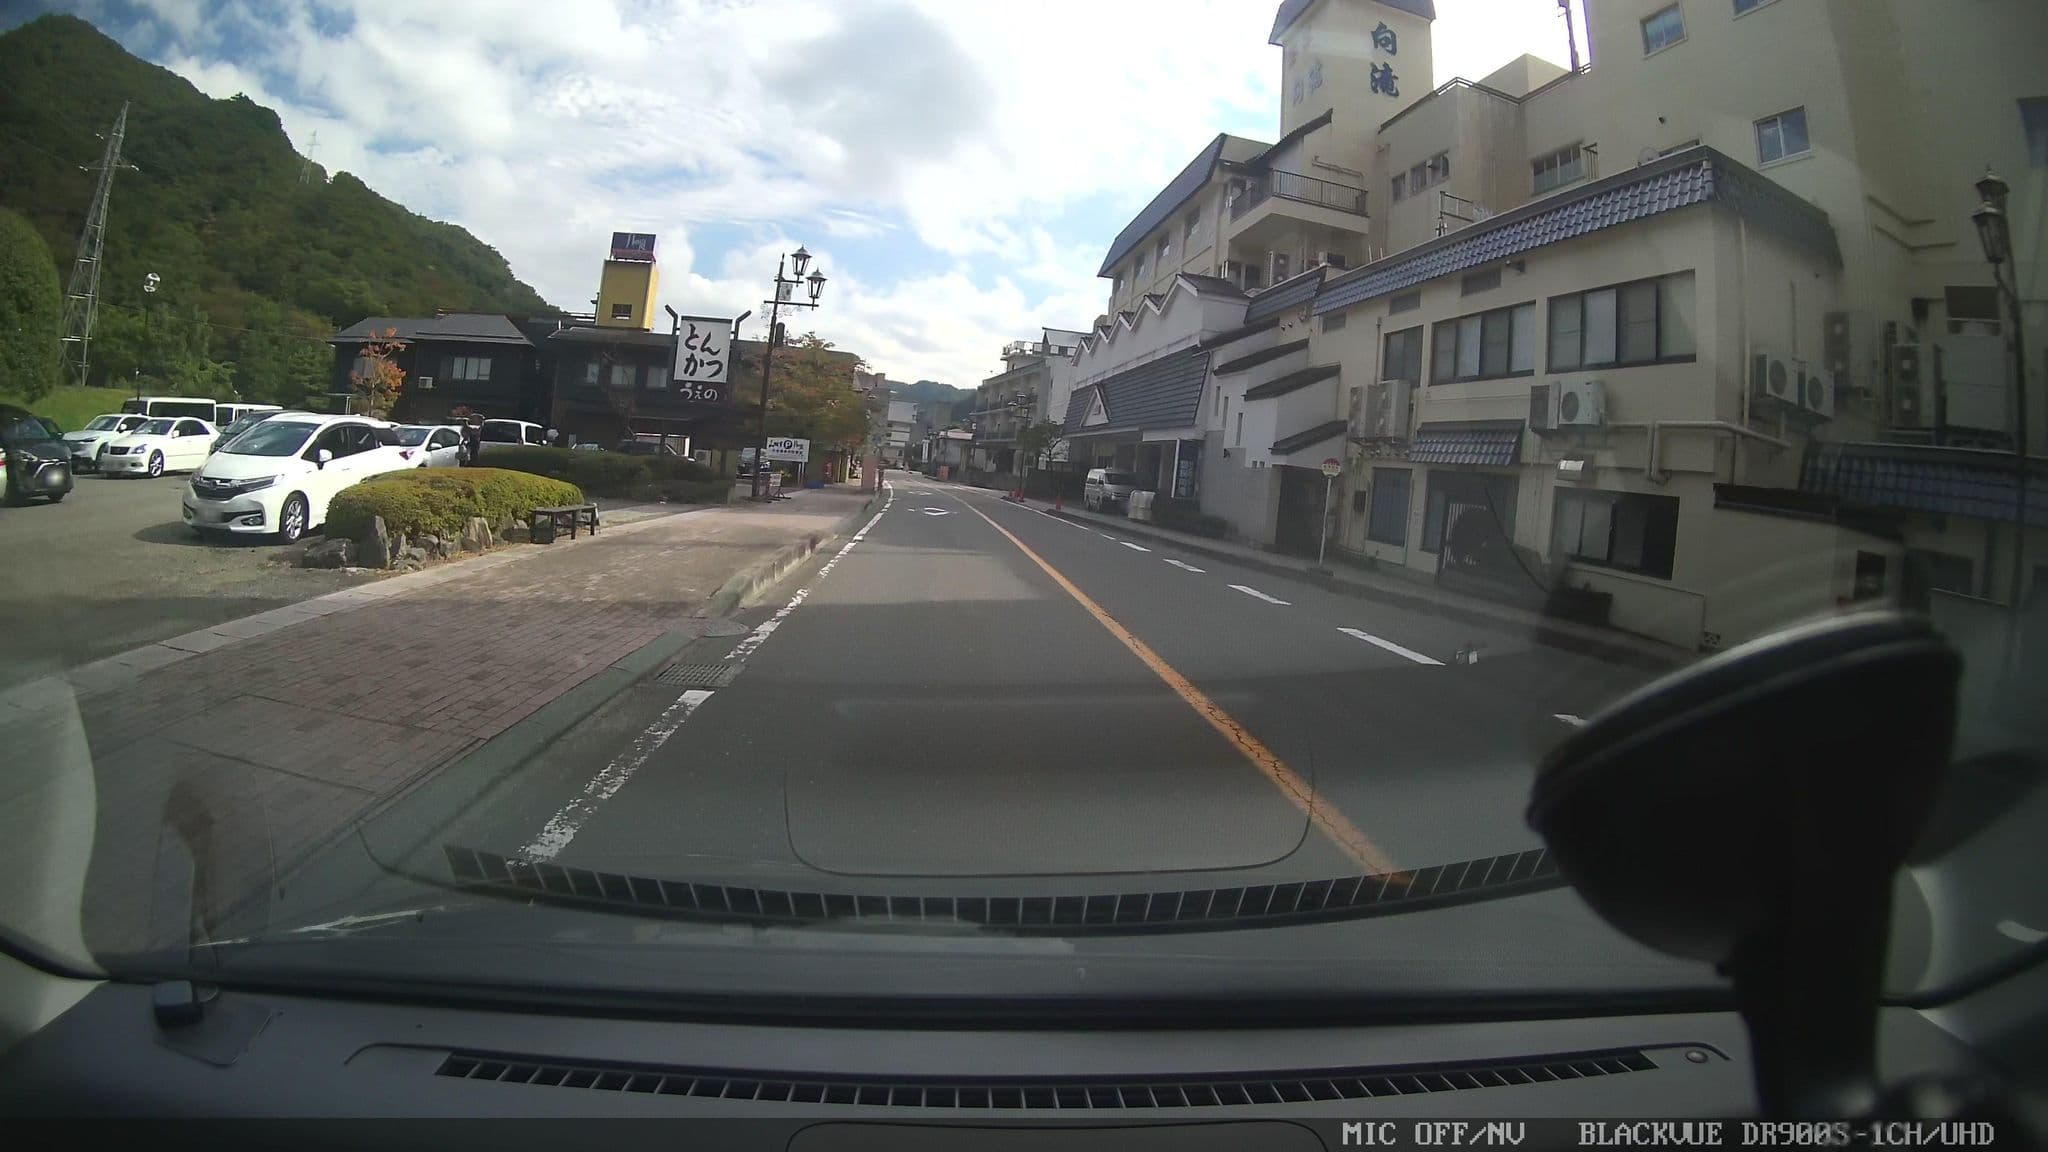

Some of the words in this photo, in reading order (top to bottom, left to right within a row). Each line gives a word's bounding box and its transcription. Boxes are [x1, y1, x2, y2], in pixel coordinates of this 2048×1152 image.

[684, 323, 721, 356] とん
[683, 352, 723, 378] かつ
[680, 382, 718, 401] うえの
